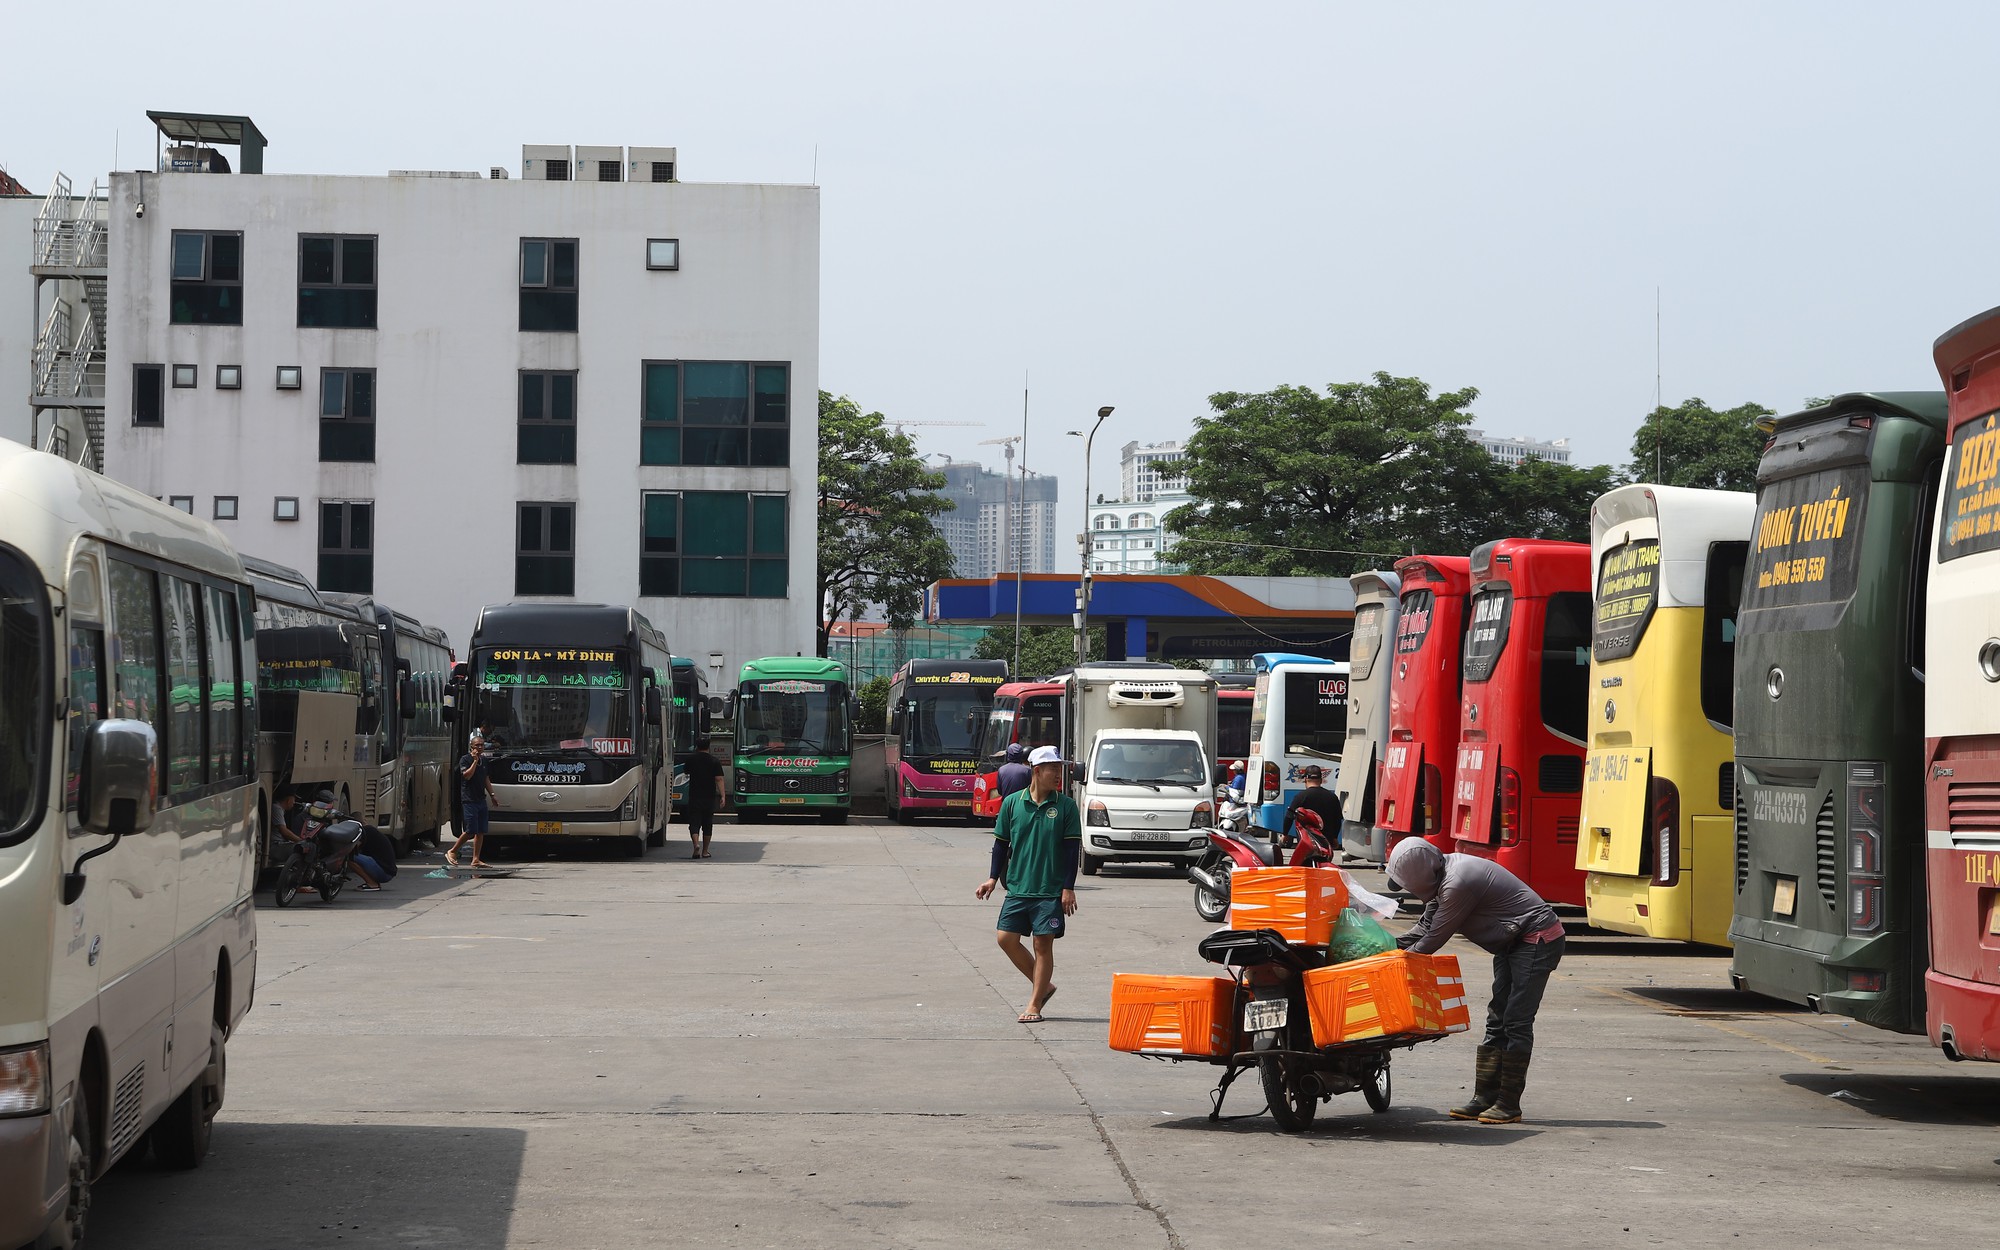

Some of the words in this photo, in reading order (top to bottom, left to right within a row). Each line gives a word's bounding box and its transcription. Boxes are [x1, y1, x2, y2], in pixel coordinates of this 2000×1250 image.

[1758, 506, 1797, 553] QUANG
[1797, 485, 1850, 543] TUYẾN
[1791, 558, 1807, 584] 558
[1808, 556, 1826, 582] 558
[494, 650, 520, 660] SƠN
[524, 651, 541, 660] LA
[557, 650, 576, 660] MỸ
[579, 651, 614, 662] ĐÌNH
[485, 674, 522, 684] SƠN
[527, 675, 548, 684] LA
[563, 674, 587, 685] HÀ
[949, 672, 971, 683] 22
[1319, 680, 1346, 697] LẠC
[594, 740, 616, 753] SƠN
[618, 741, 630, 753] LA
[1753, 790, 1807, 825] 22H-03373
